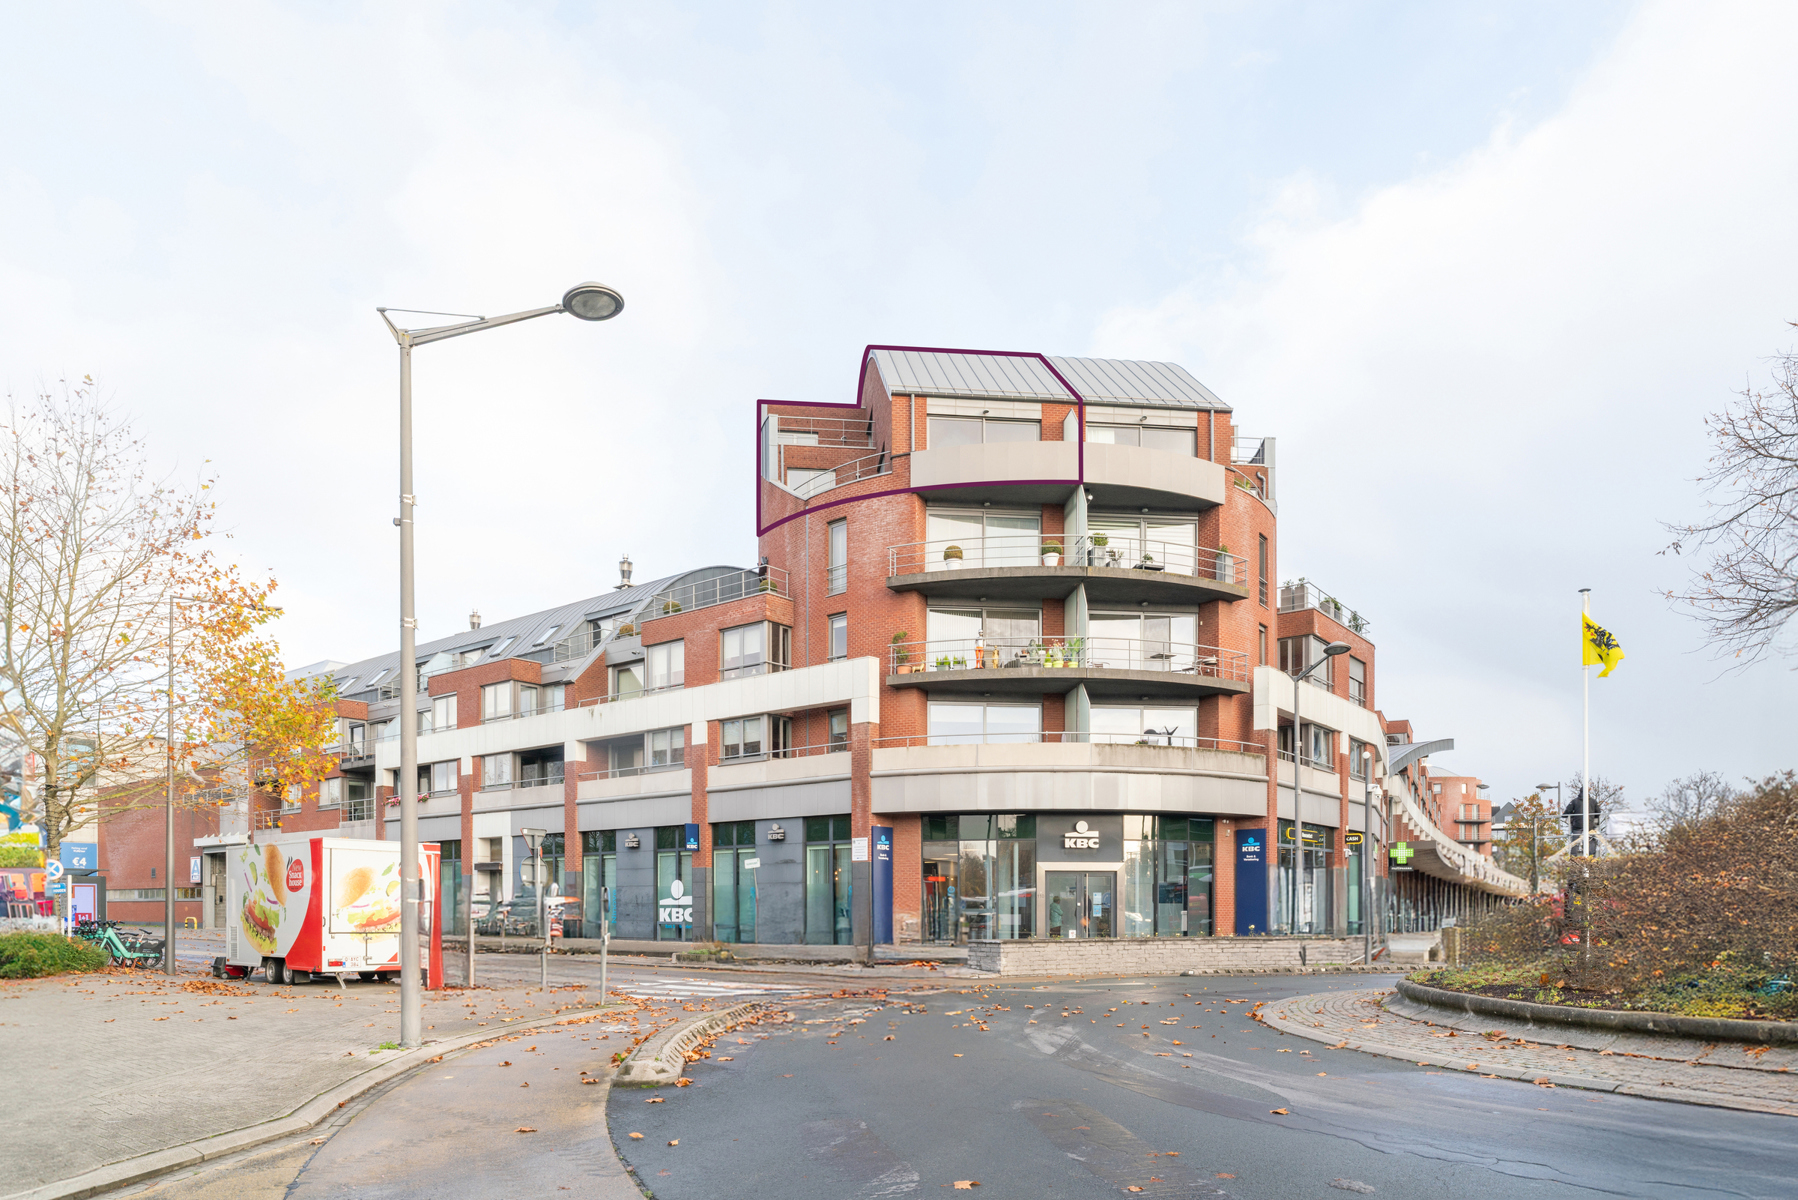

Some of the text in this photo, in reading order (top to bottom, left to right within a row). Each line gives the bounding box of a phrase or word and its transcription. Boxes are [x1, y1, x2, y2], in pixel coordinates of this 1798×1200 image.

[1064, 838, 1100, 849] KBC
[72, 857, 87, 866] €4
[288, 878, 302, 886] house
[659, 907, 693, 922] KBC
